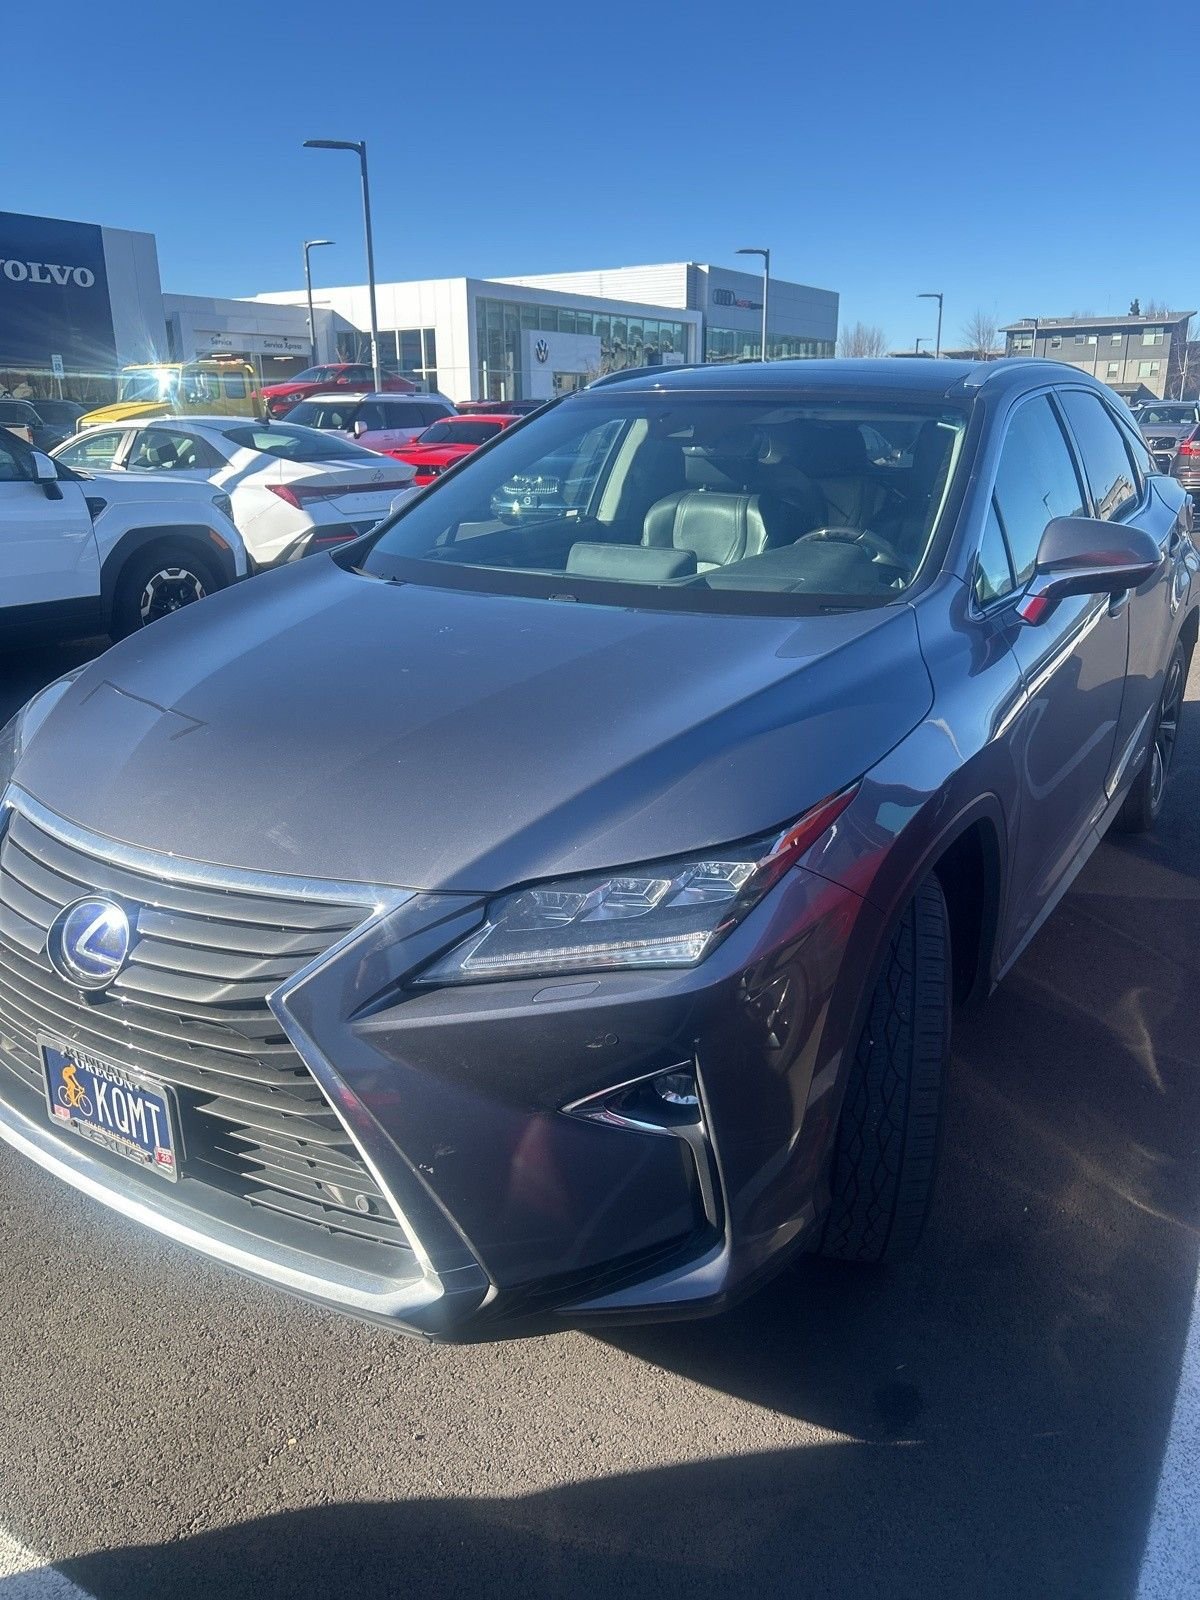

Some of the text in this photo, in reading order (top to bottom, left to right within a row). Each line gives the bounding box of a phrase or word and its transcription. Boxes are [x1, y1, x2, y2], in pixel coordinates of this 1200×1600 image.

[0, 259, 95, 288] OLVO
[210, 336, 232, 346] Service
[263, 340, 283, 349] Service
[74, 1057, 134, 1092] OREGON
[92, 1077, 160, 1146] KQMT
